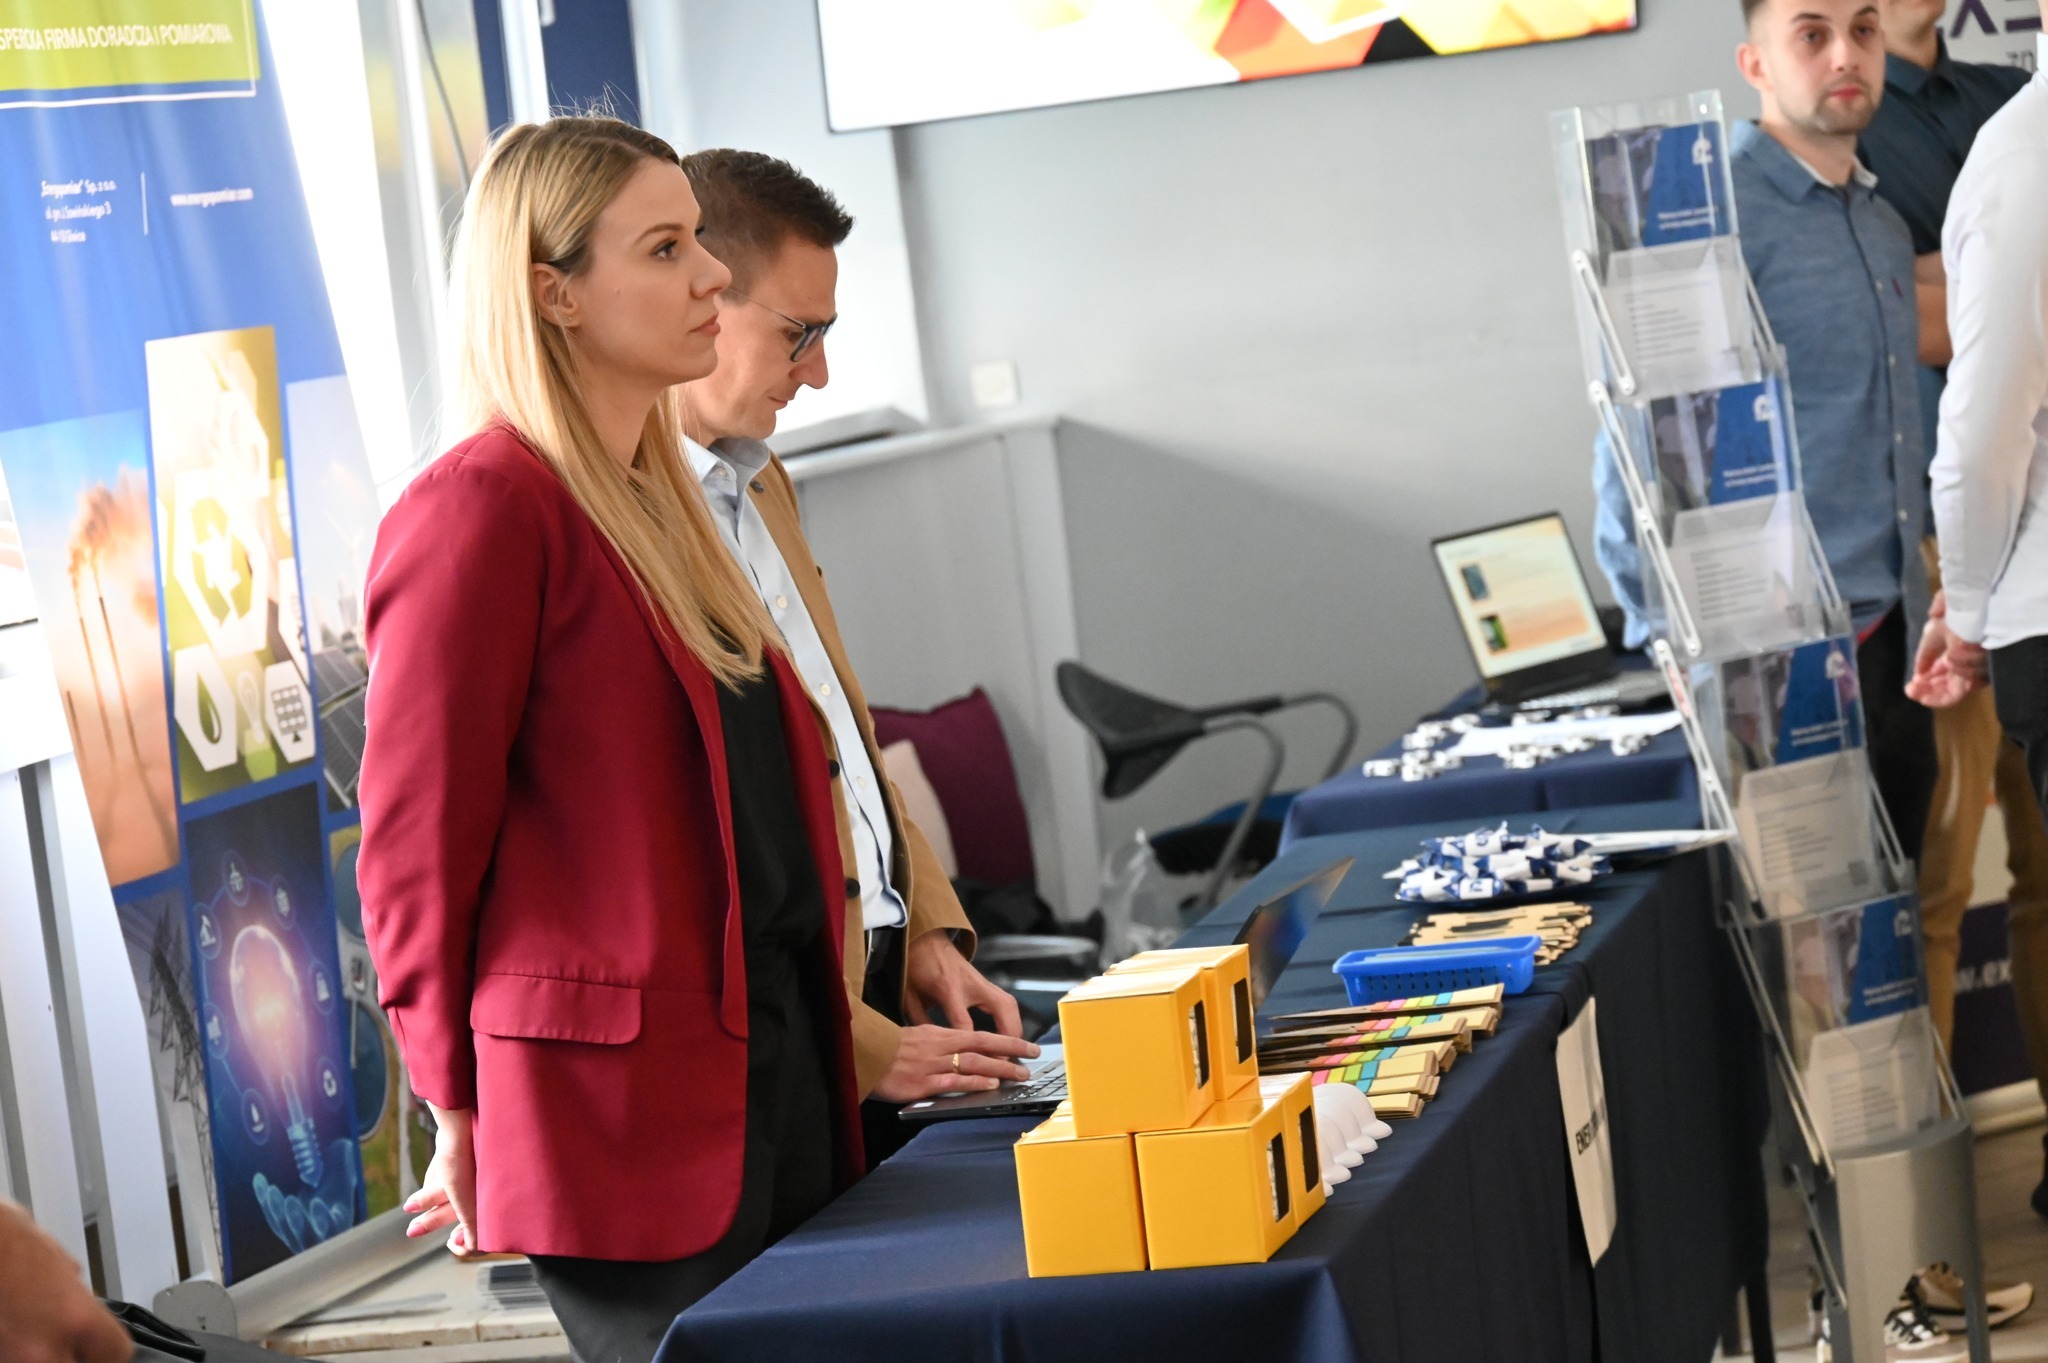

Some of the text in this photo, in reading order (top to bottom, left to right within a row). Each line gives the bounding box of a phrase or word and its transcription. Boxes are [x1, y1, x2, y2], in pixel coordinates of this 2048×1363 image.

[45, 27, 88, 49] FIRMA
[89, 25, 153, 48] DORADCZA
[153, 25, 160, 46] I
[160, 23, 232, 45] POMIAROWA
